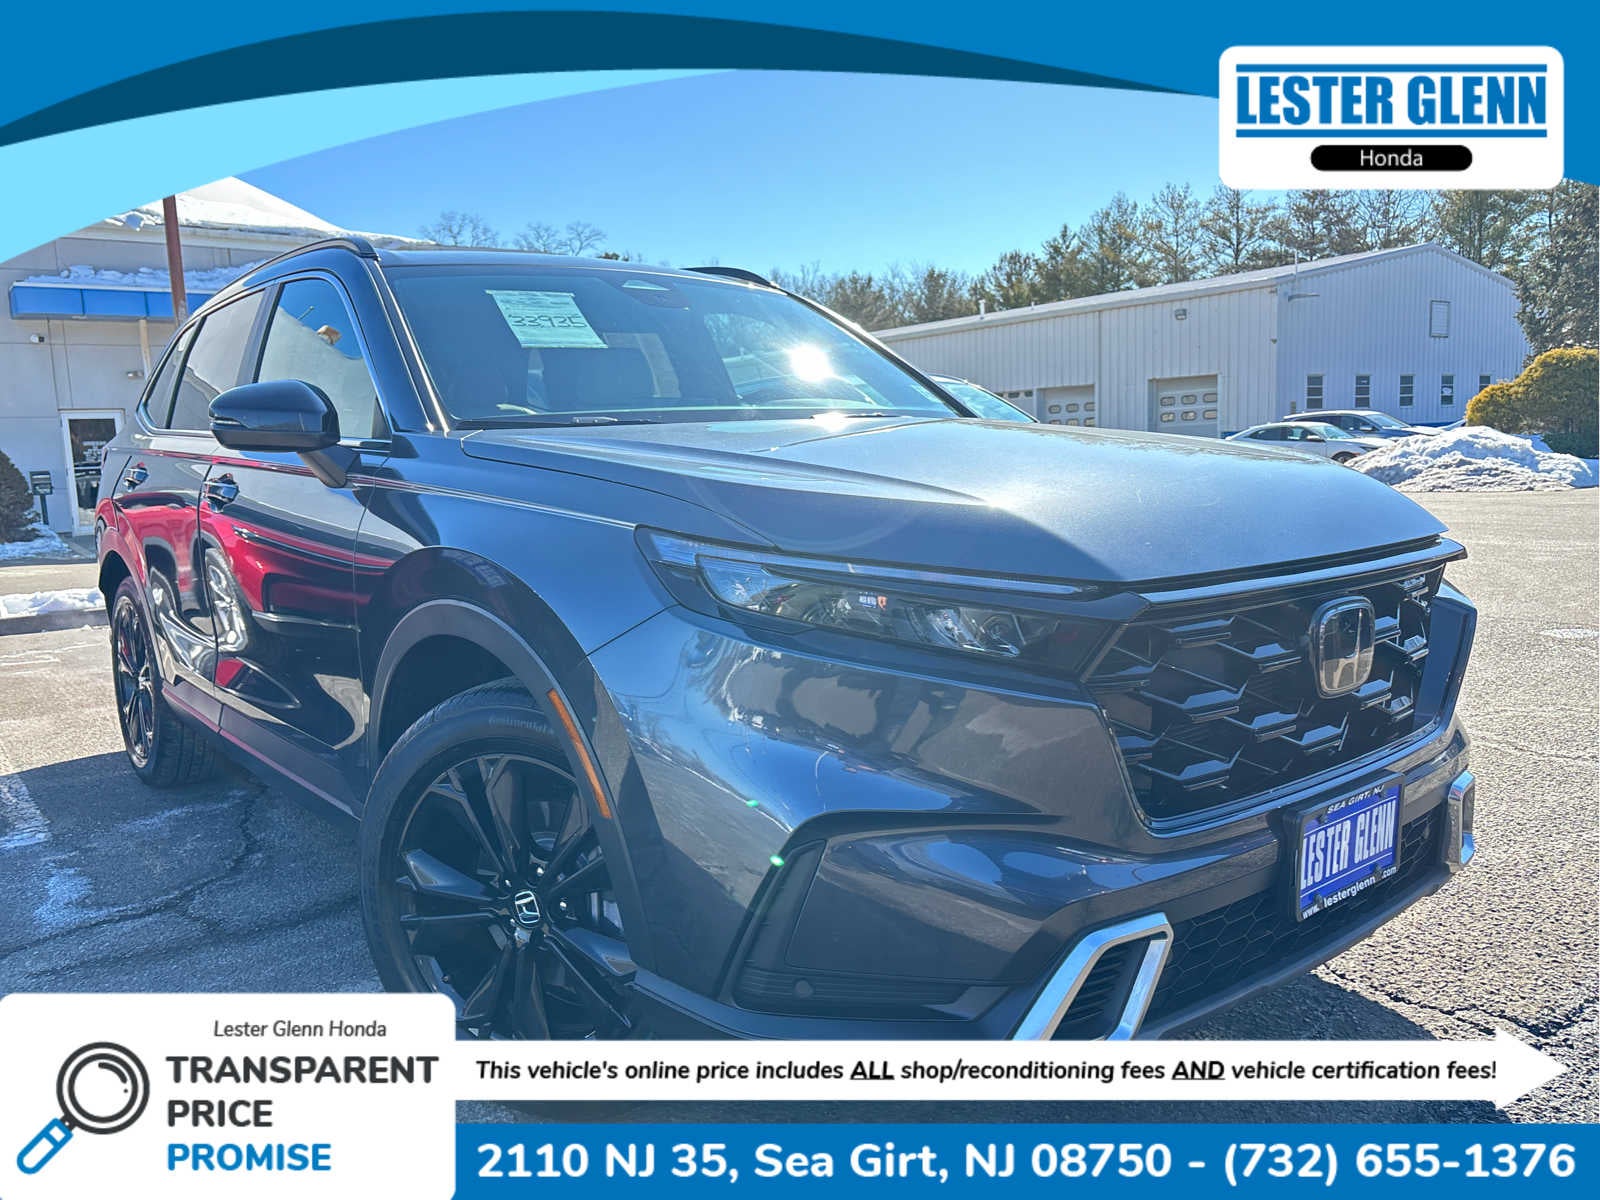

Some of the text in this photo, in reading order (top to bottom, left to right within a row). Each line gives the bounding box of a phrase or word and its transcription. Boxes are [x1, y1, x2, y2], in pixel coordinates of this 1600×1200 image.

[1327, 801, 1346, 814] SEA
[1372, 785, 1385, 797] NJ
[1300, 800, 1396, 889] LESTER GLENN
